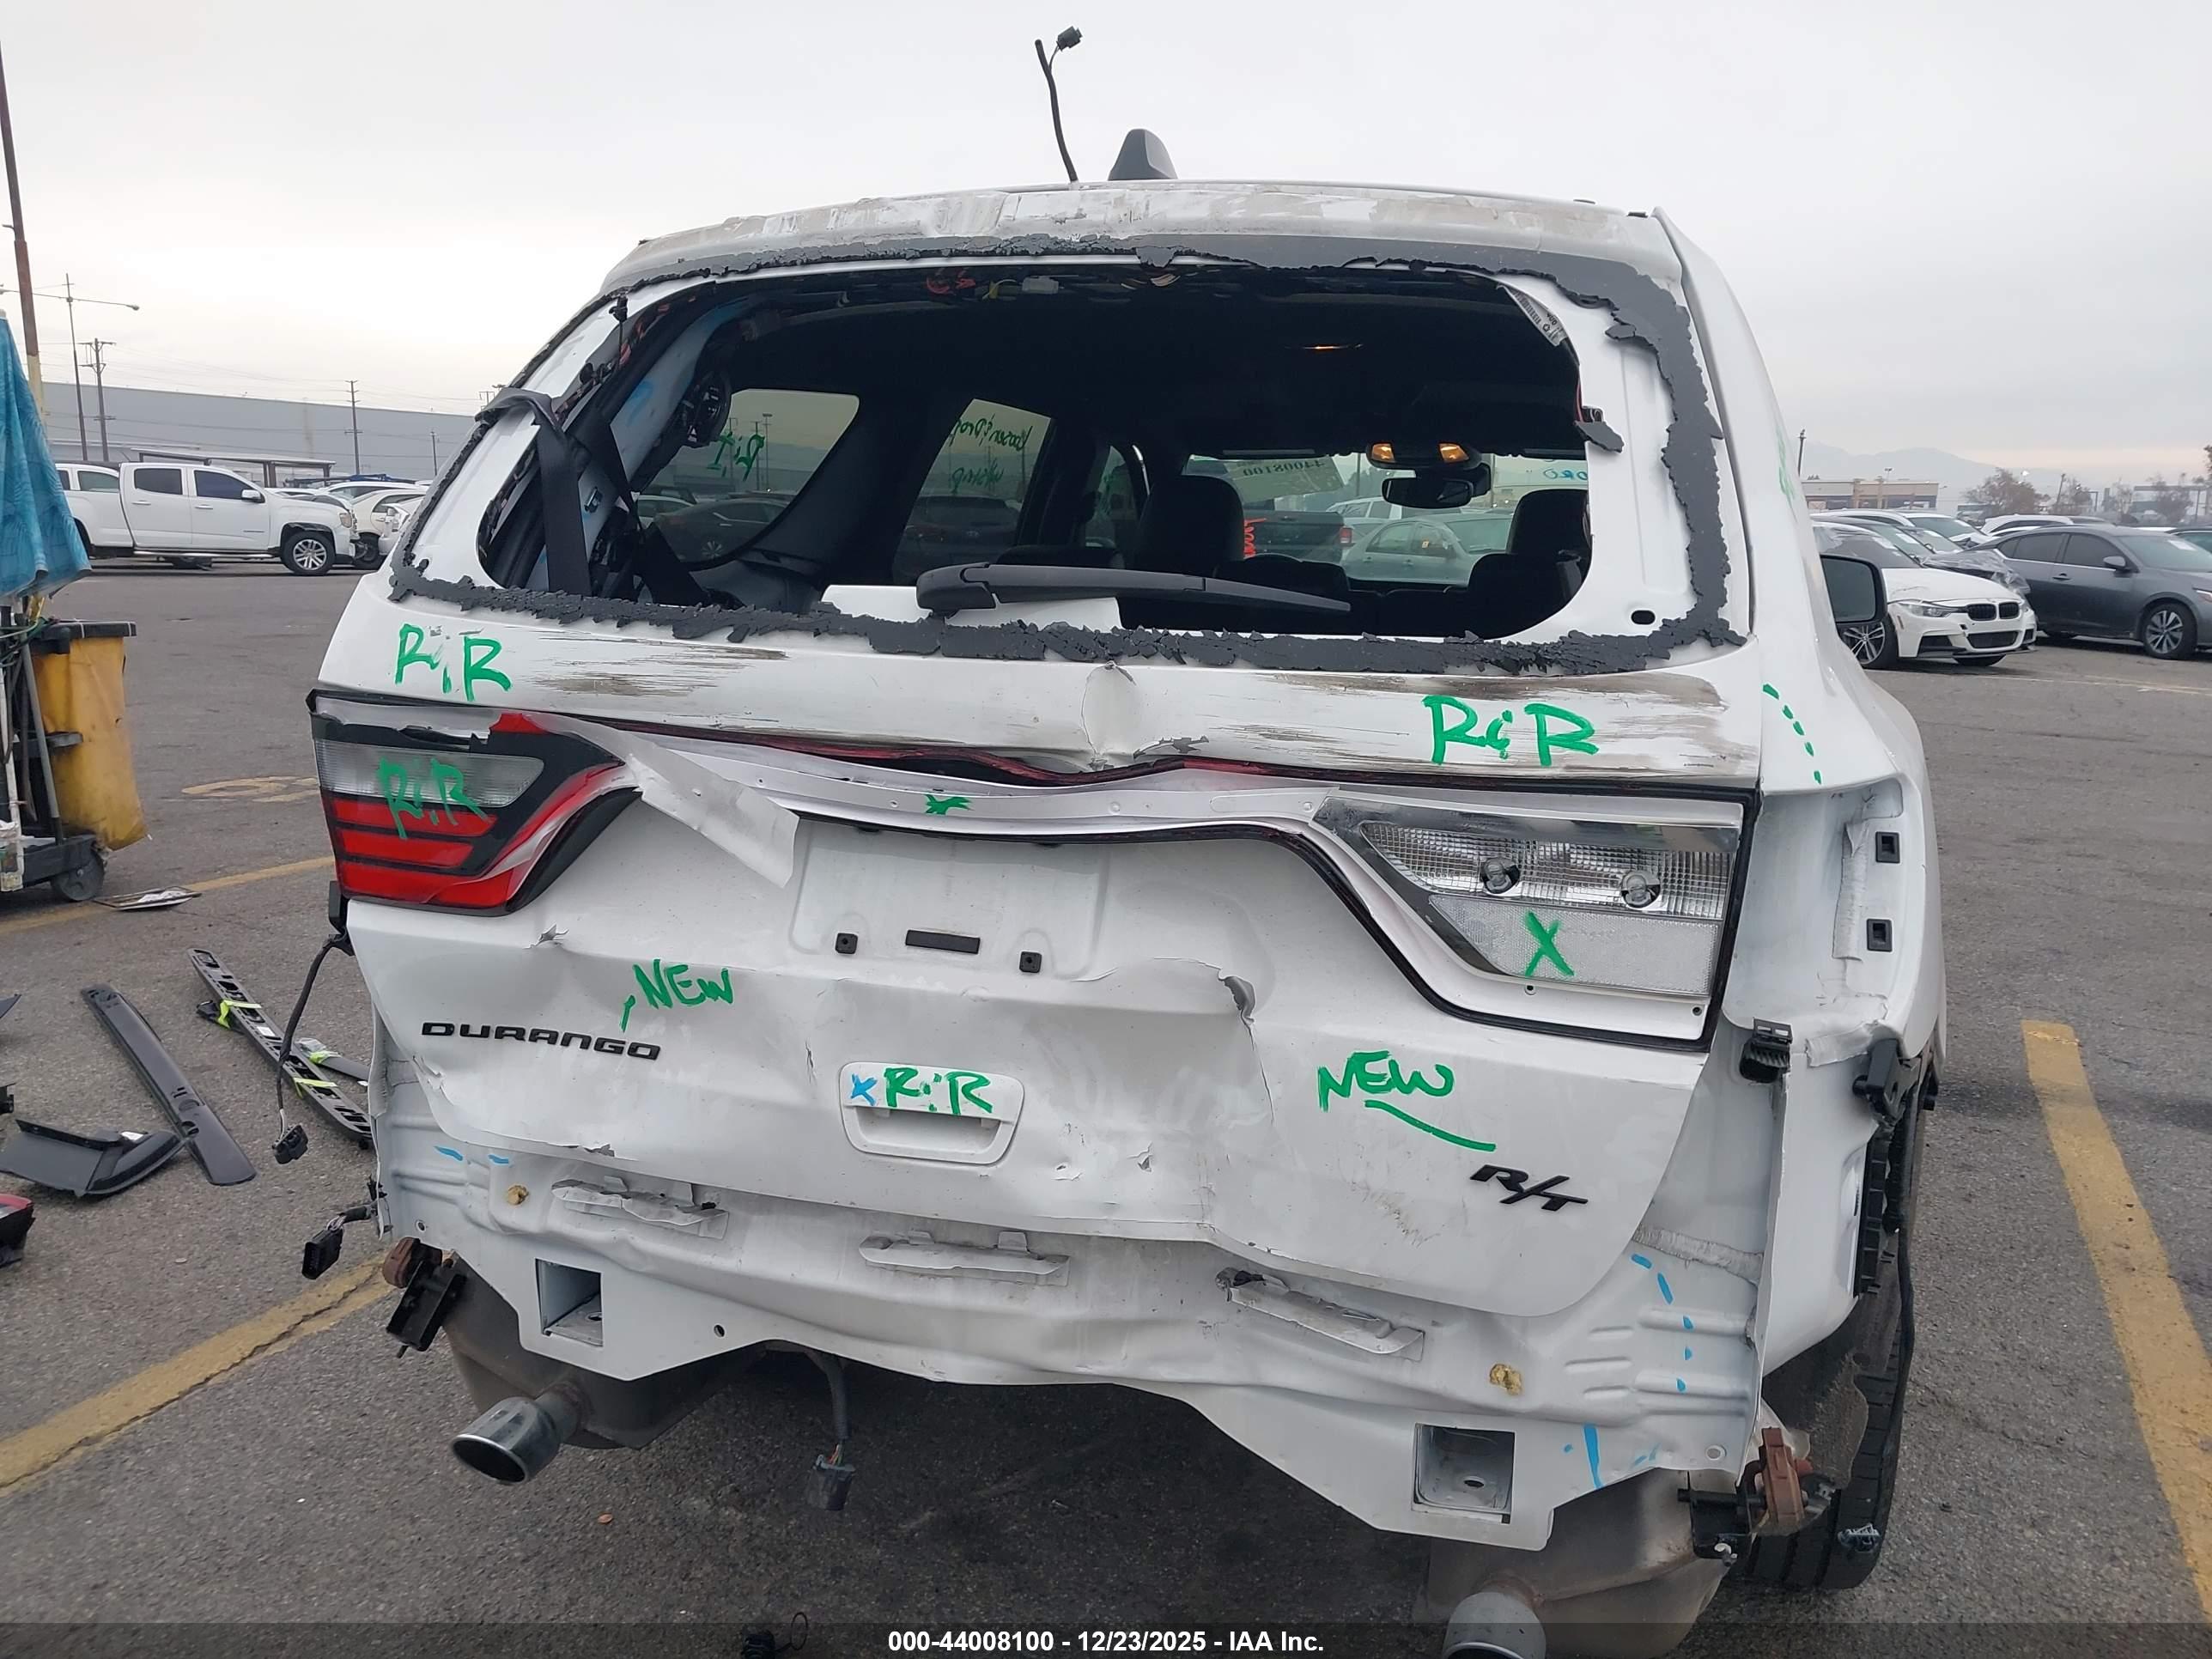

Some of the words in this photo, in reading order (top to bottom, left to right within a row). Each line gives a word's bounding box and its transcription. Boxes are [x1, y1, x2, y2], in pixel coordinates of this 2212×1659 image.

[422, 1021, 661, 1061] DURANGO
[1317, 1049, 1455, 1113] NEW
[1469, 1164, 1589, 1212] R/T
